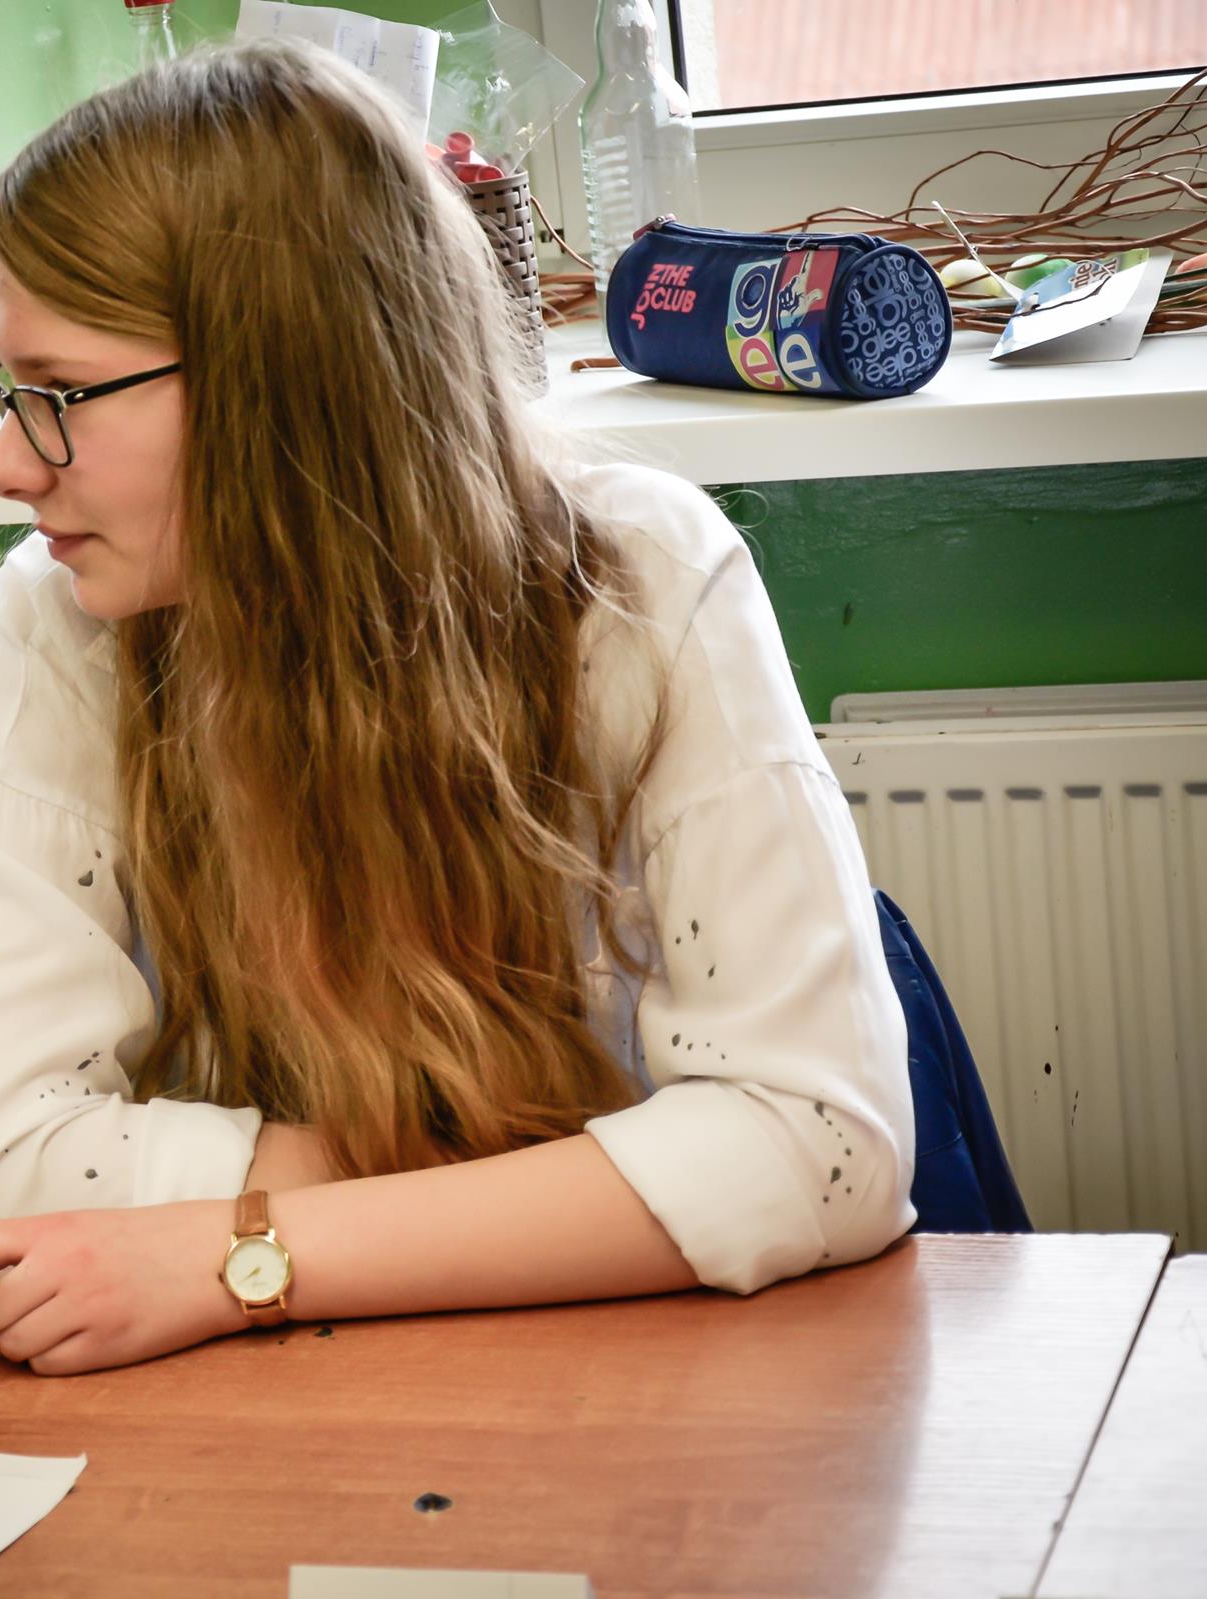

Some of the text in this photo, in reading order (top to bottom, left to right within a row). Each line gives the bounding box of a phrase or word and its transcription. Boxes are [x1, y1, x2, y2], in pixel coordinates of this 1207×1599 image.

[659, 265, 695, 287] THE
[631, 264, 666, 331] JOIN
[651, 287, 697, 313] CLUB
[861, 321, 911, 363] glee
